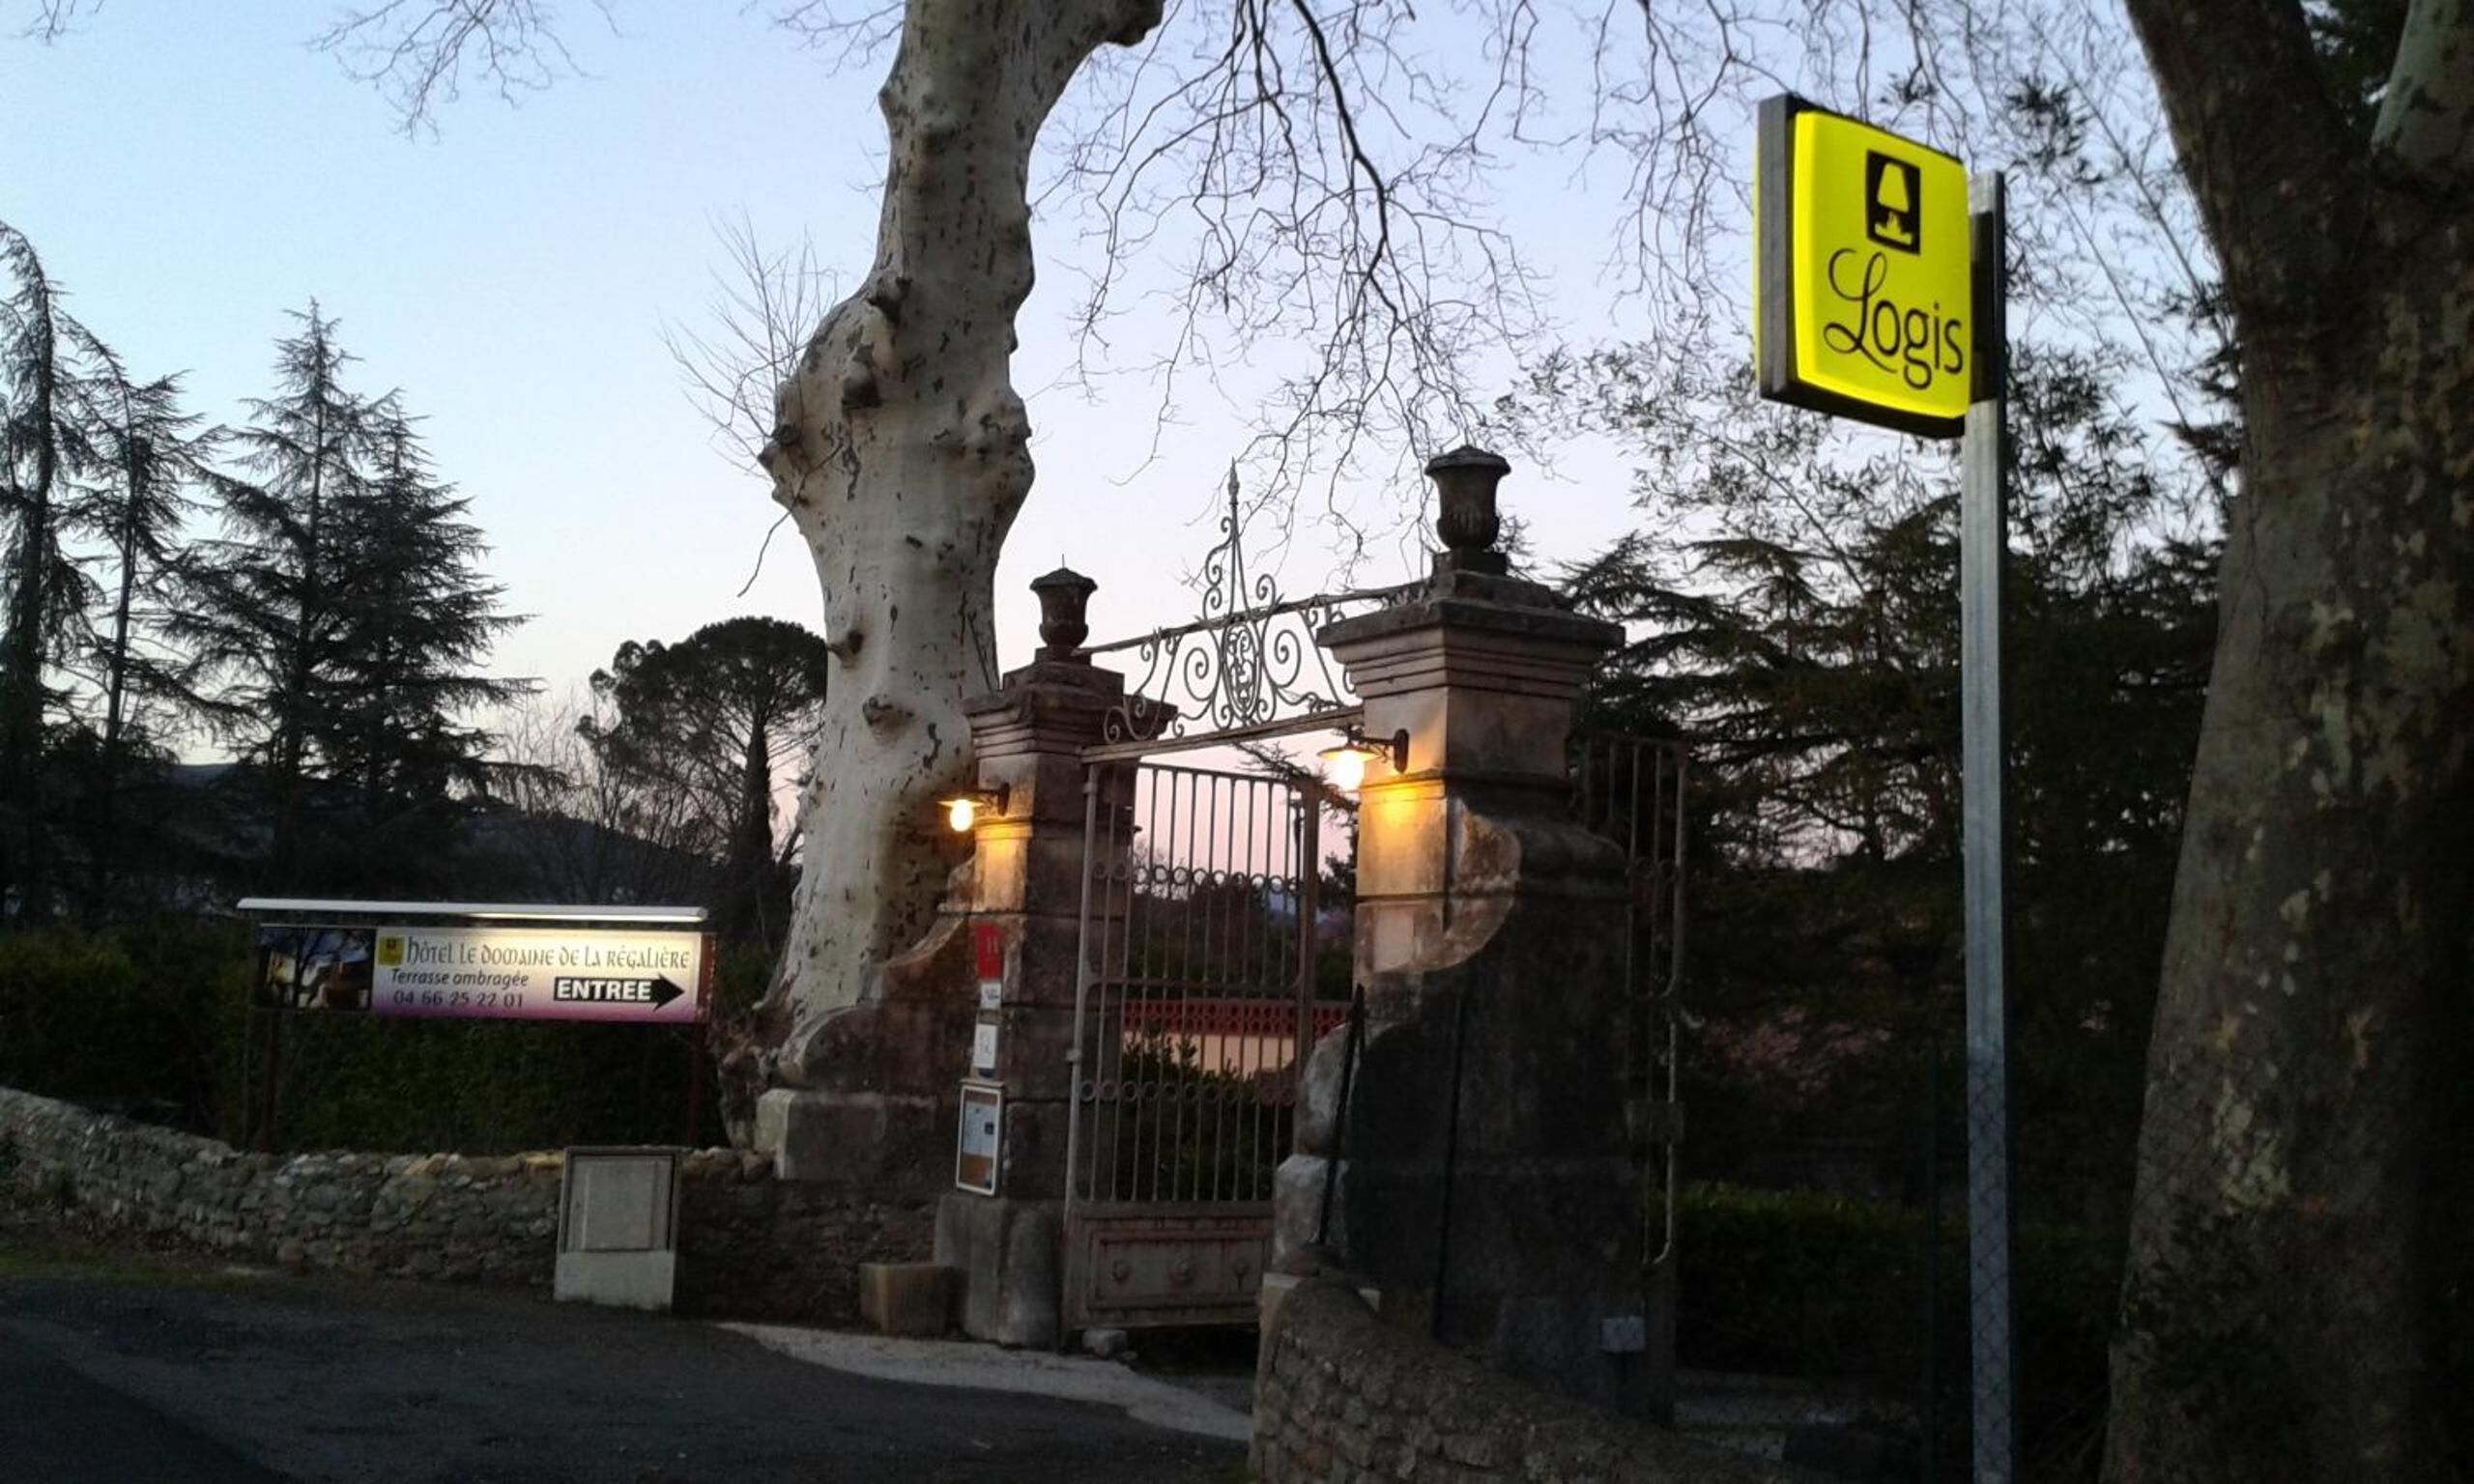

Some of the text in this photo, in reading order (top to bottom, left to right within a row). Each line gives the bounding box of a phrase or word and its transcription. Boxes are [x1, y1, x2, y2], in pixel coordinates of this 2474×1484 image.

[1824, 247, 1964, 390] Logis
[391, 968, 529, 990] Terrasse ombragée
[557, 979, 652, 1001] ENTREE
[393, 989, 414, 1005] 04
[449, 991, 470, 1007] 25
[476, 992, 497, 1007] 22
[503, 993, 523, 1008] 01
